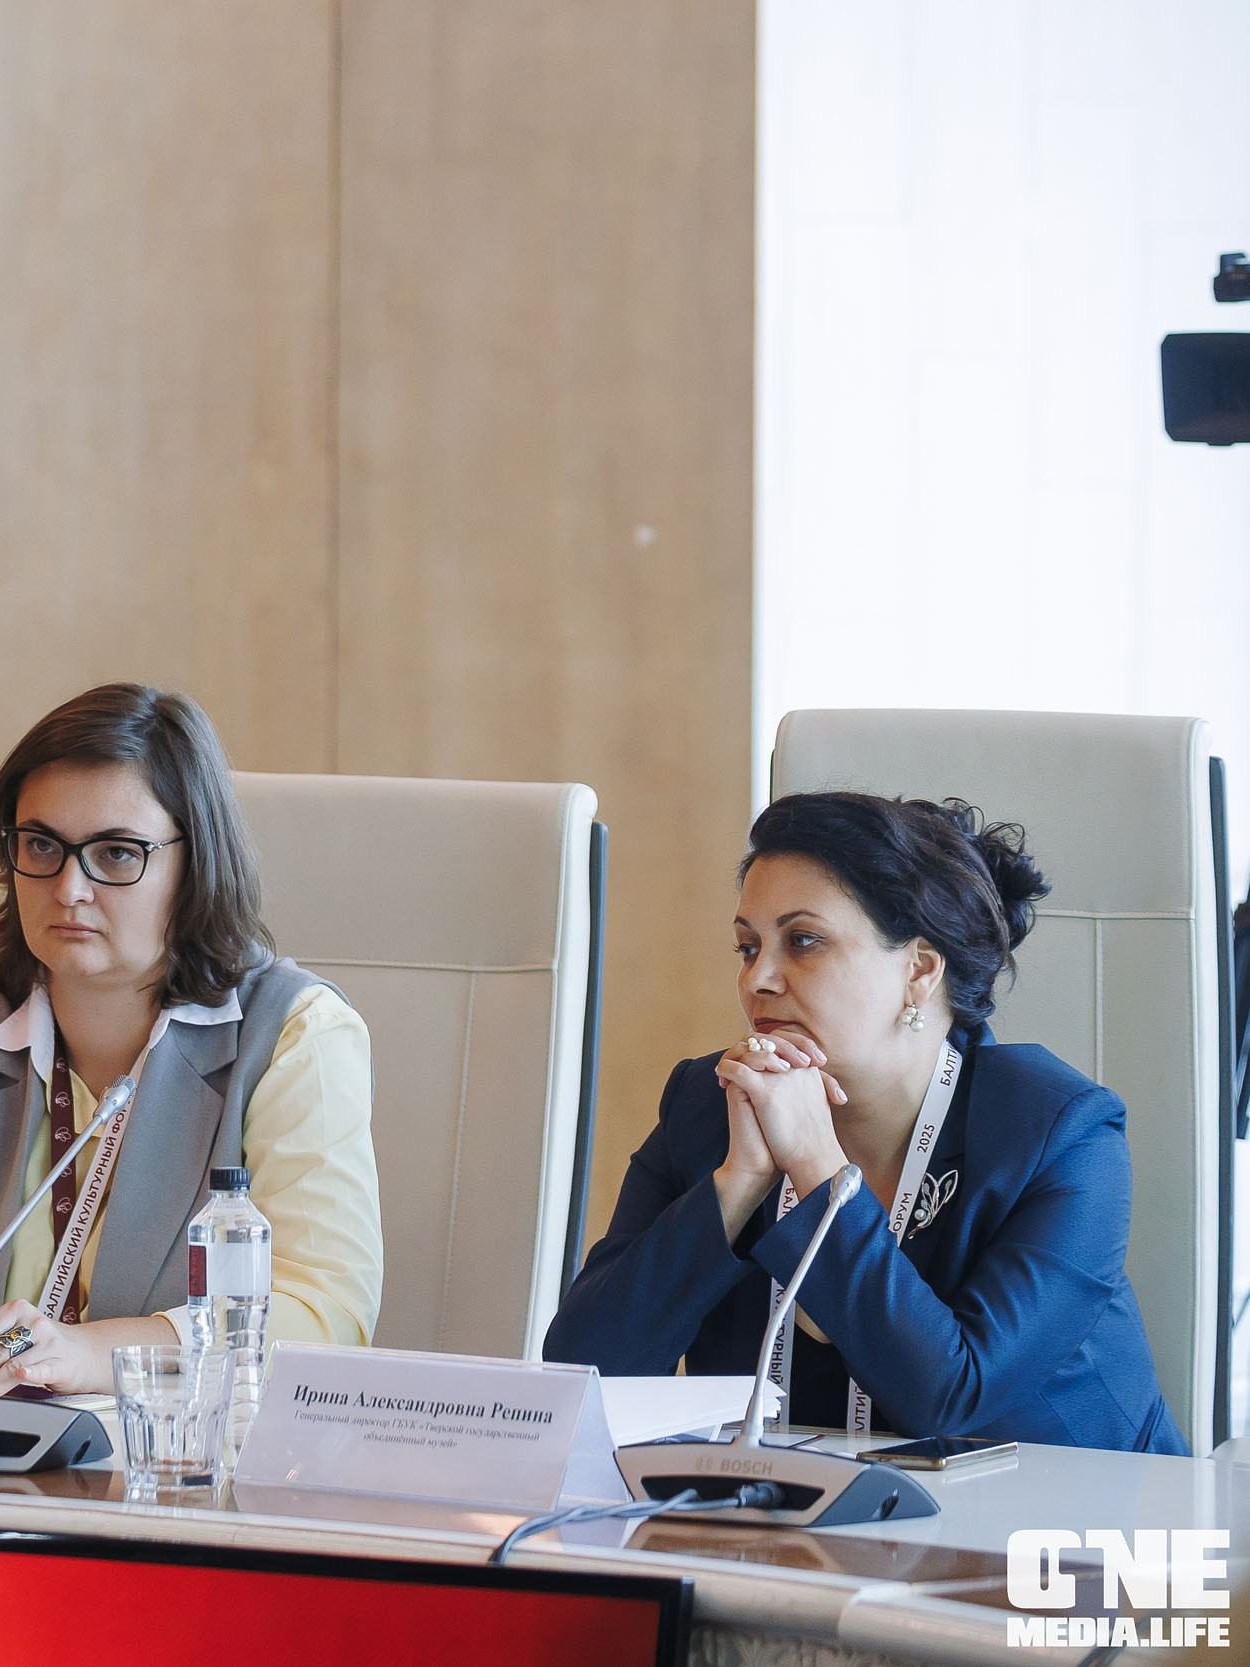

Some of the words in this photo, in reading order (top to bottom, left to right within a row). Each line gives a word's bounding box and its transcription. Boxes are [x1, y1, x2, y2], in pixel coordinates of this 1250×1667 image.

[917, 1124, 935, 1153] 2025
[77, 1136, 117, 1226] КУЛЬТУРНЫЙ
[892, 1192, 913, 1232] ОРУМ
[292, 1385, 349, 1408] Ирина
[352, 1391, 486, 1419] Александровна
[490, 1401, 554, 1424] Репина
[293, 1409, 350, 1424] Генеральный
[351, 1417, 391, 1429] директор
[465, 1428, 541, 1441] государственный
[720, 1458, 773, 1476] BOSCH
